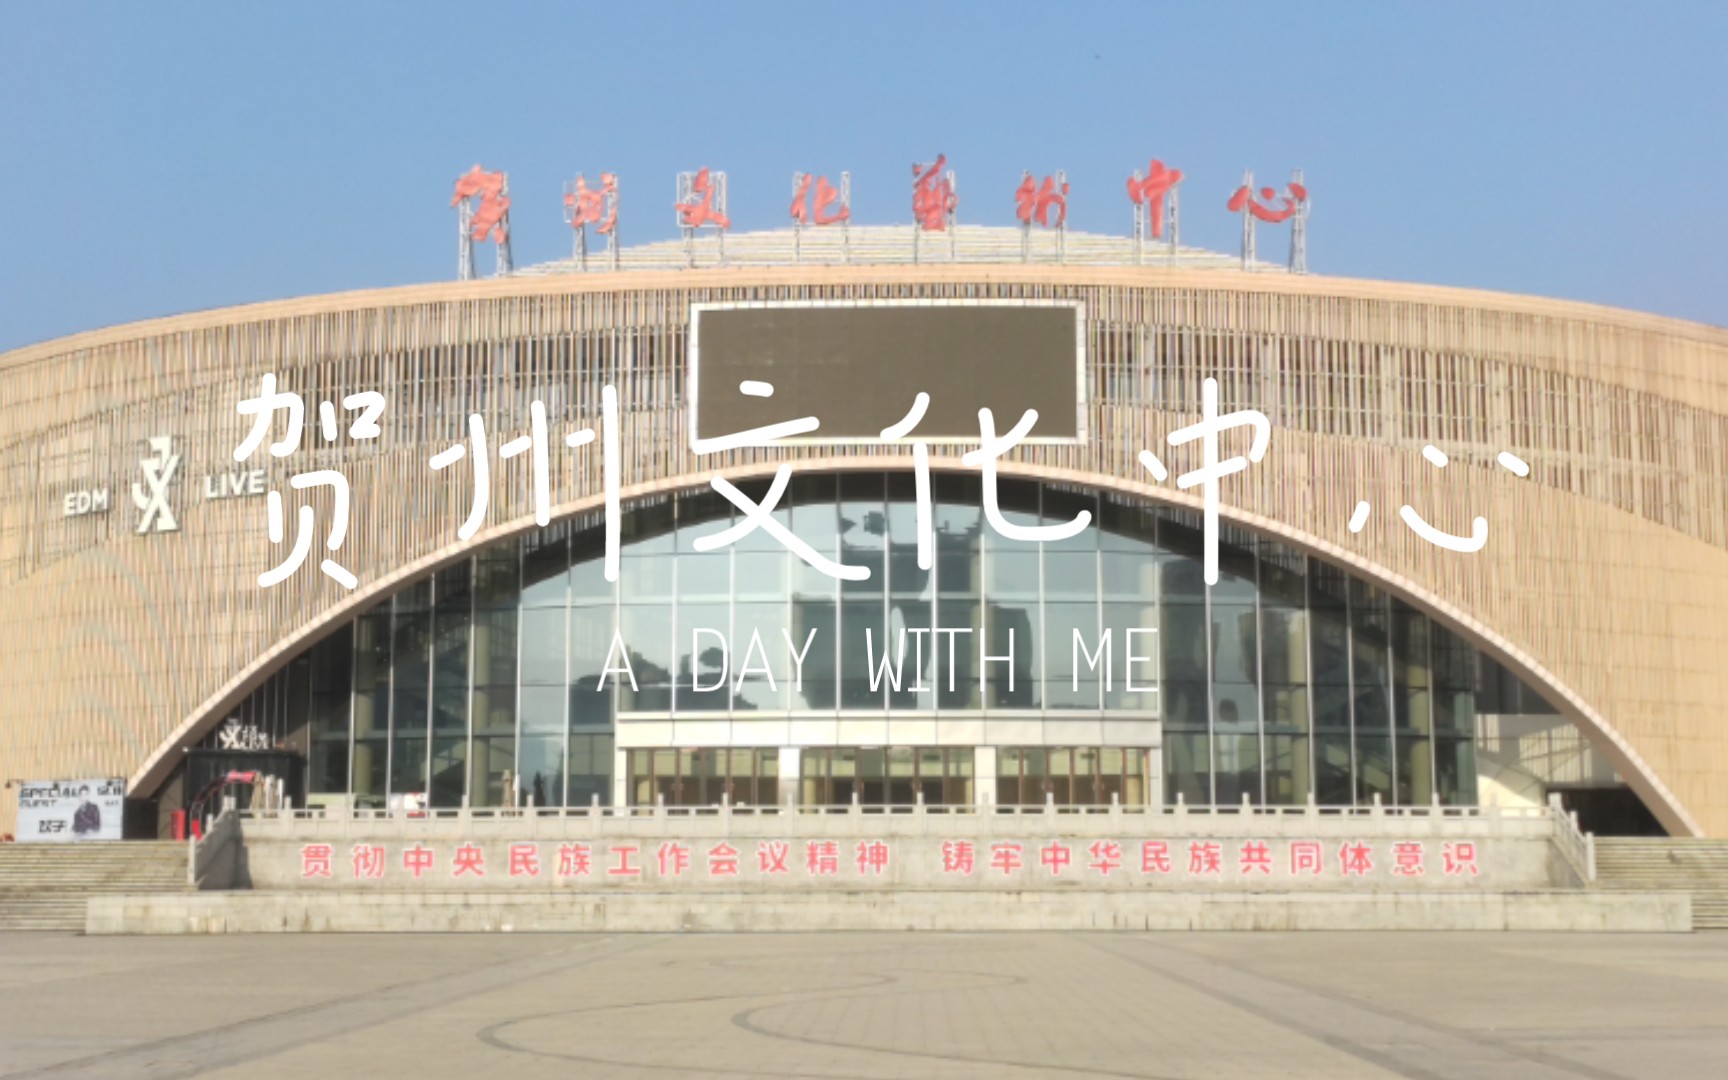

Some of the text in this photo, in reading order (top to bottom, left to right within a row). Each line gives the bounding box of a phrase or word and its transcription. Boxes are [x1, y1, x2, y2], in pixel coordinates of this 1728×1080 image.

[204, 469, 265, 499] LIVE
[62, 487, 109, 517] EDM
[300, 839, 1480, 880] 贯彻中央民族工作会议精神 铸牢中华民族共同体意识
